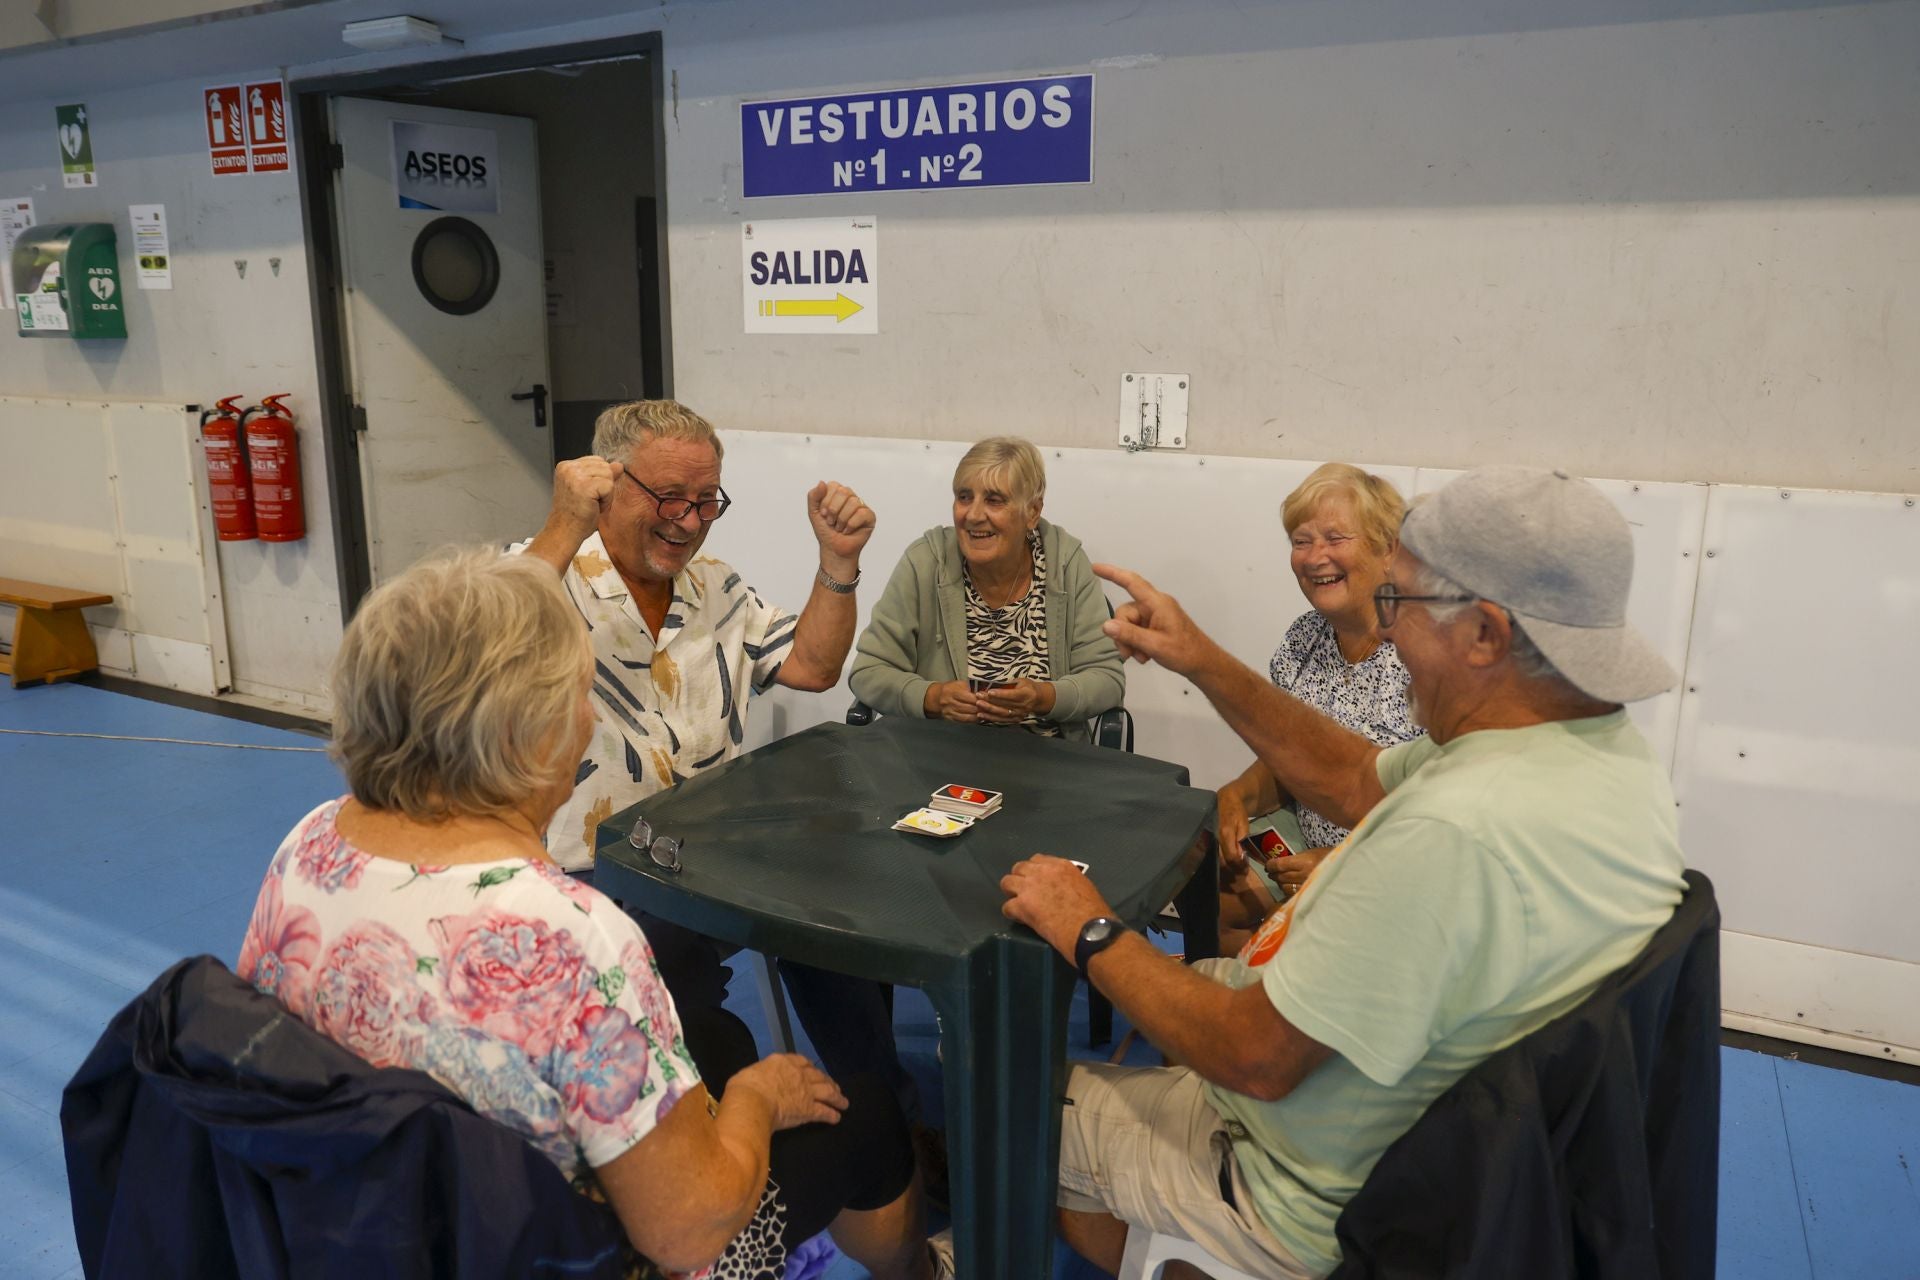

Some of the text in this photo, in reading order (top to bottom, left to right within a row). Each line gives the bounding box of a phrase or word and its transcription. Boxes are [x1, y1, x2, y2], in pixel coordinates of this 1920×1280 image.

[757, 84, 1072, 147] VESTUARIOS
[213, 155, 247, 168] EXTINTOR
[253, 152, 287, 165] EXTINTOR
[404, 150, 487, 178] ASEOS
[88, 267, 113, 275] AED
[750, 248, 869, 286] SALIDA
